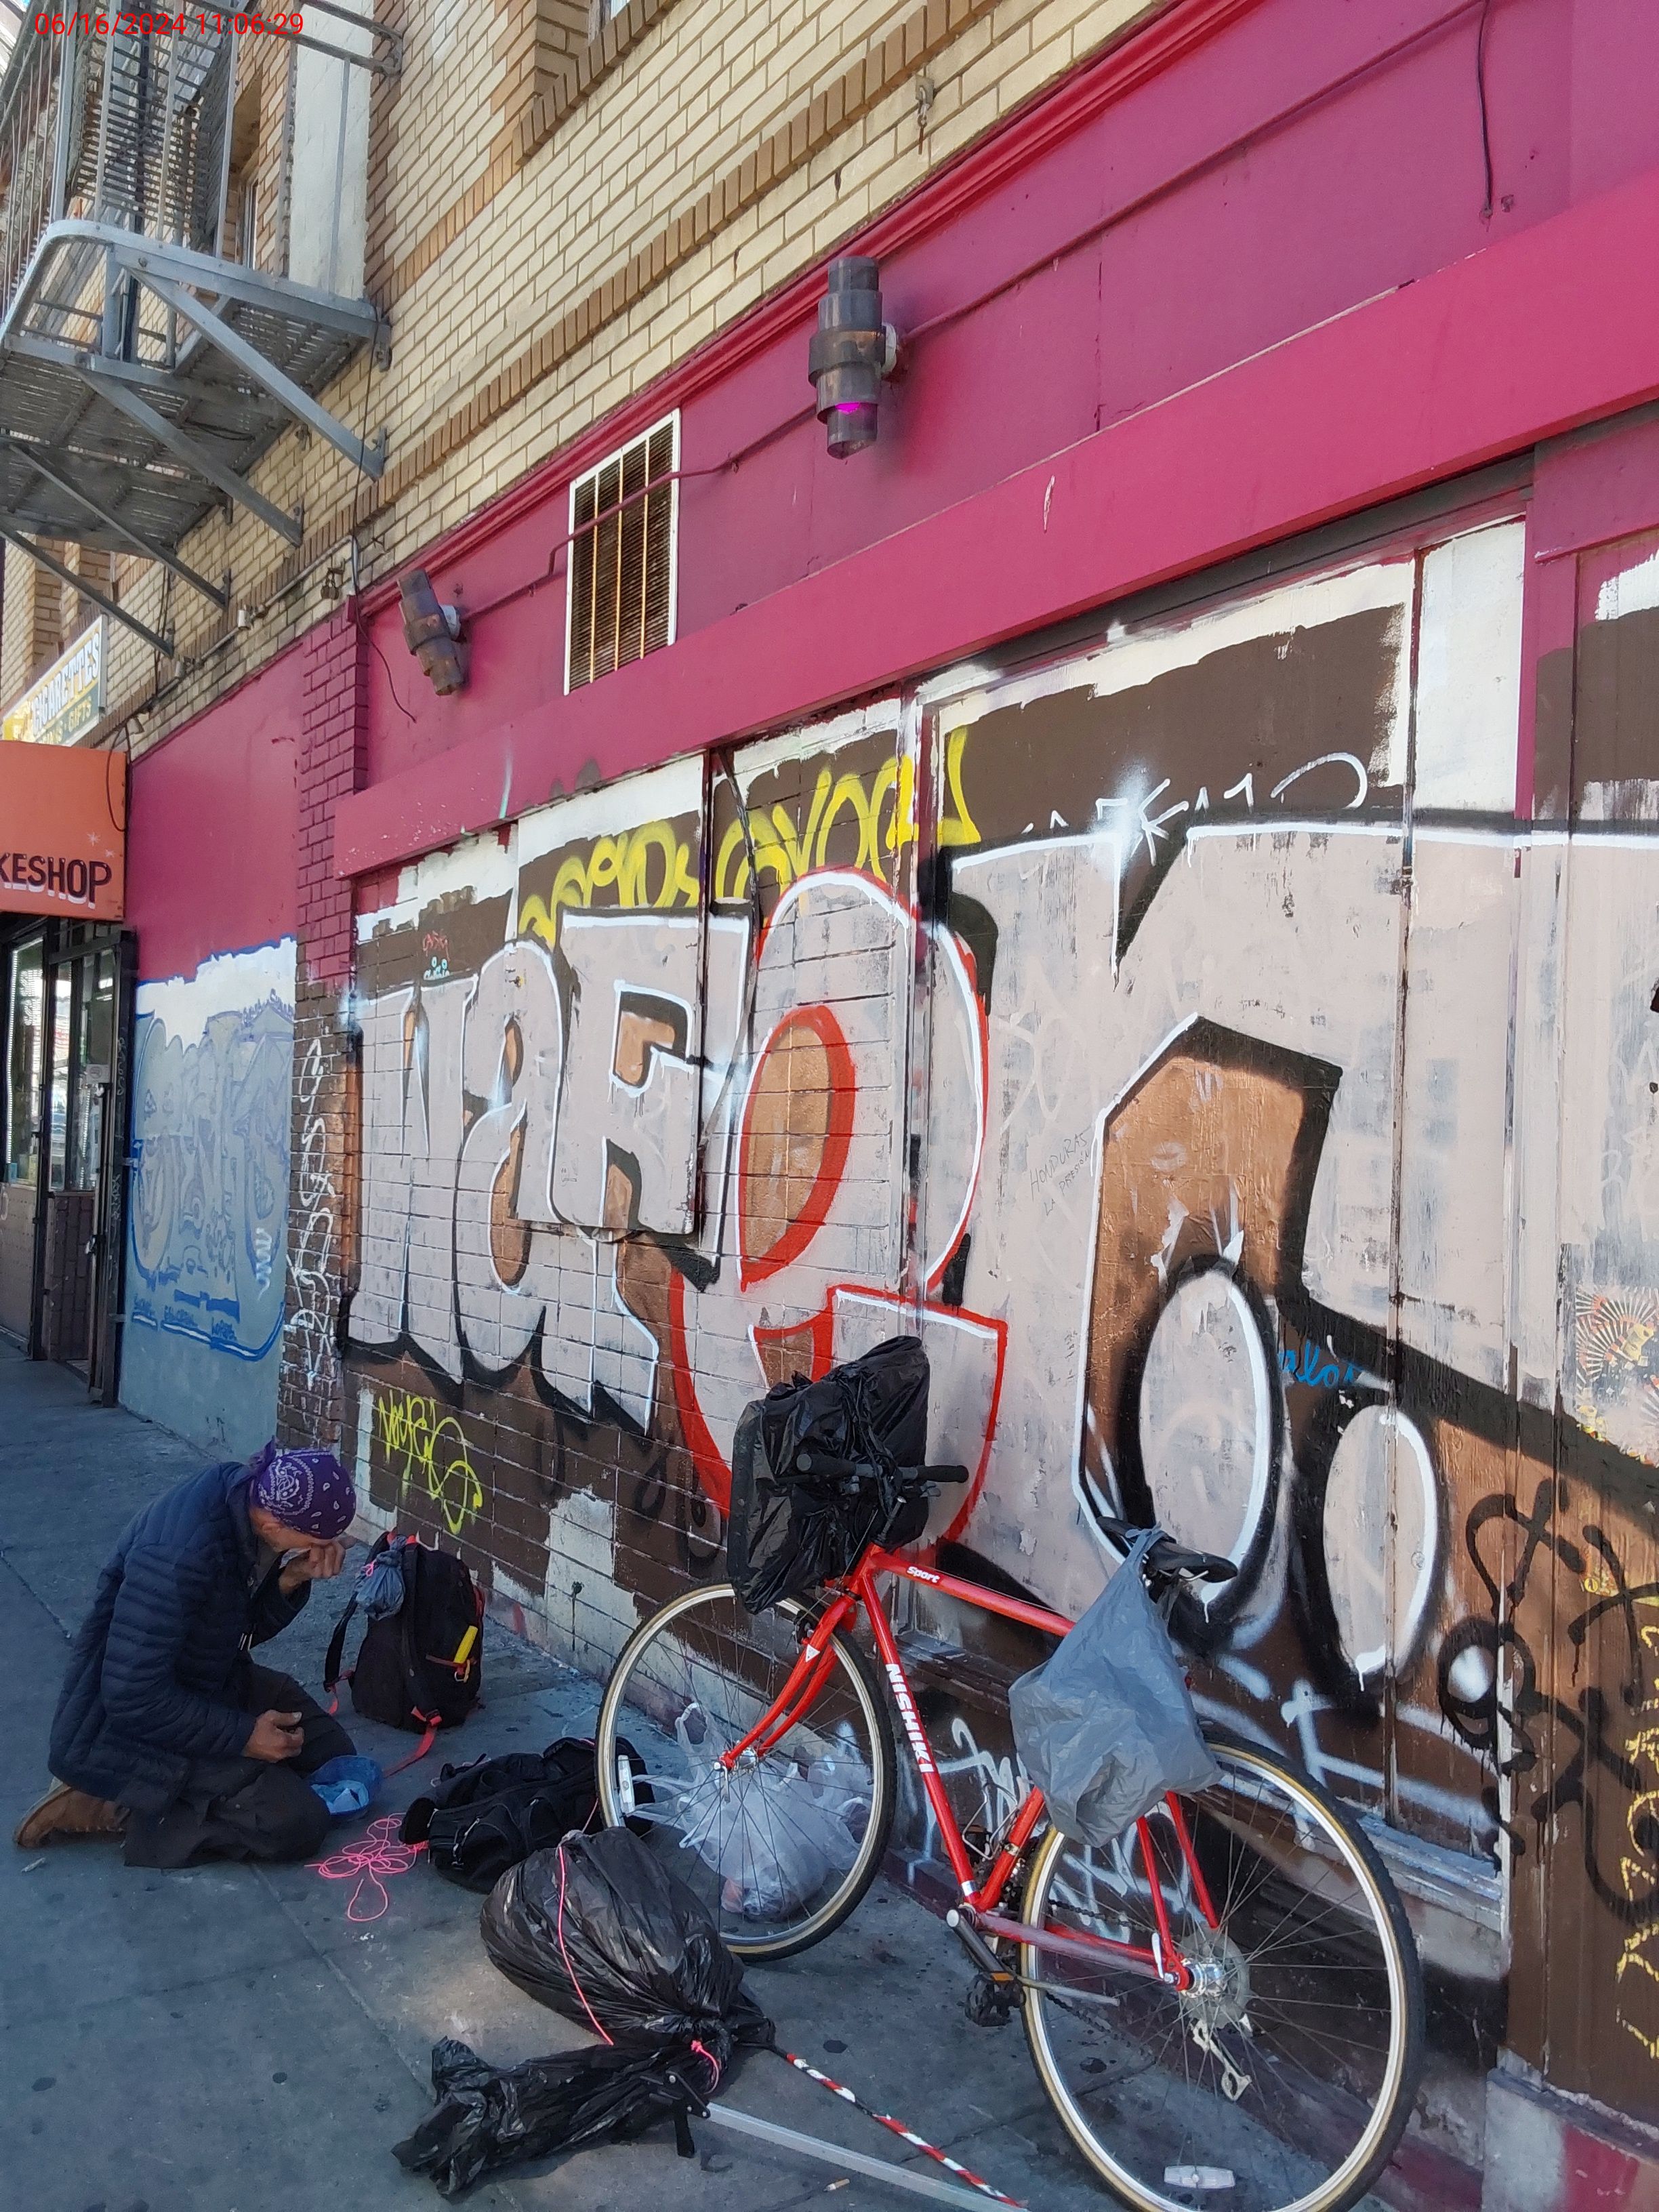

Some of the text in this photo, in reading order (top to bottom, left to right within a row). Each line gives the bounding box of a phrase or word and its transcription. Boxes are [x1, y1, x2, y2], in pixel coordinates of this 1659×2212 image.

[1029, 1132, 1088, 1202] HONDURAS
[906, 1565, 941, 1584] Sport
[885, 1662, 935, 1774] NISHIKI
